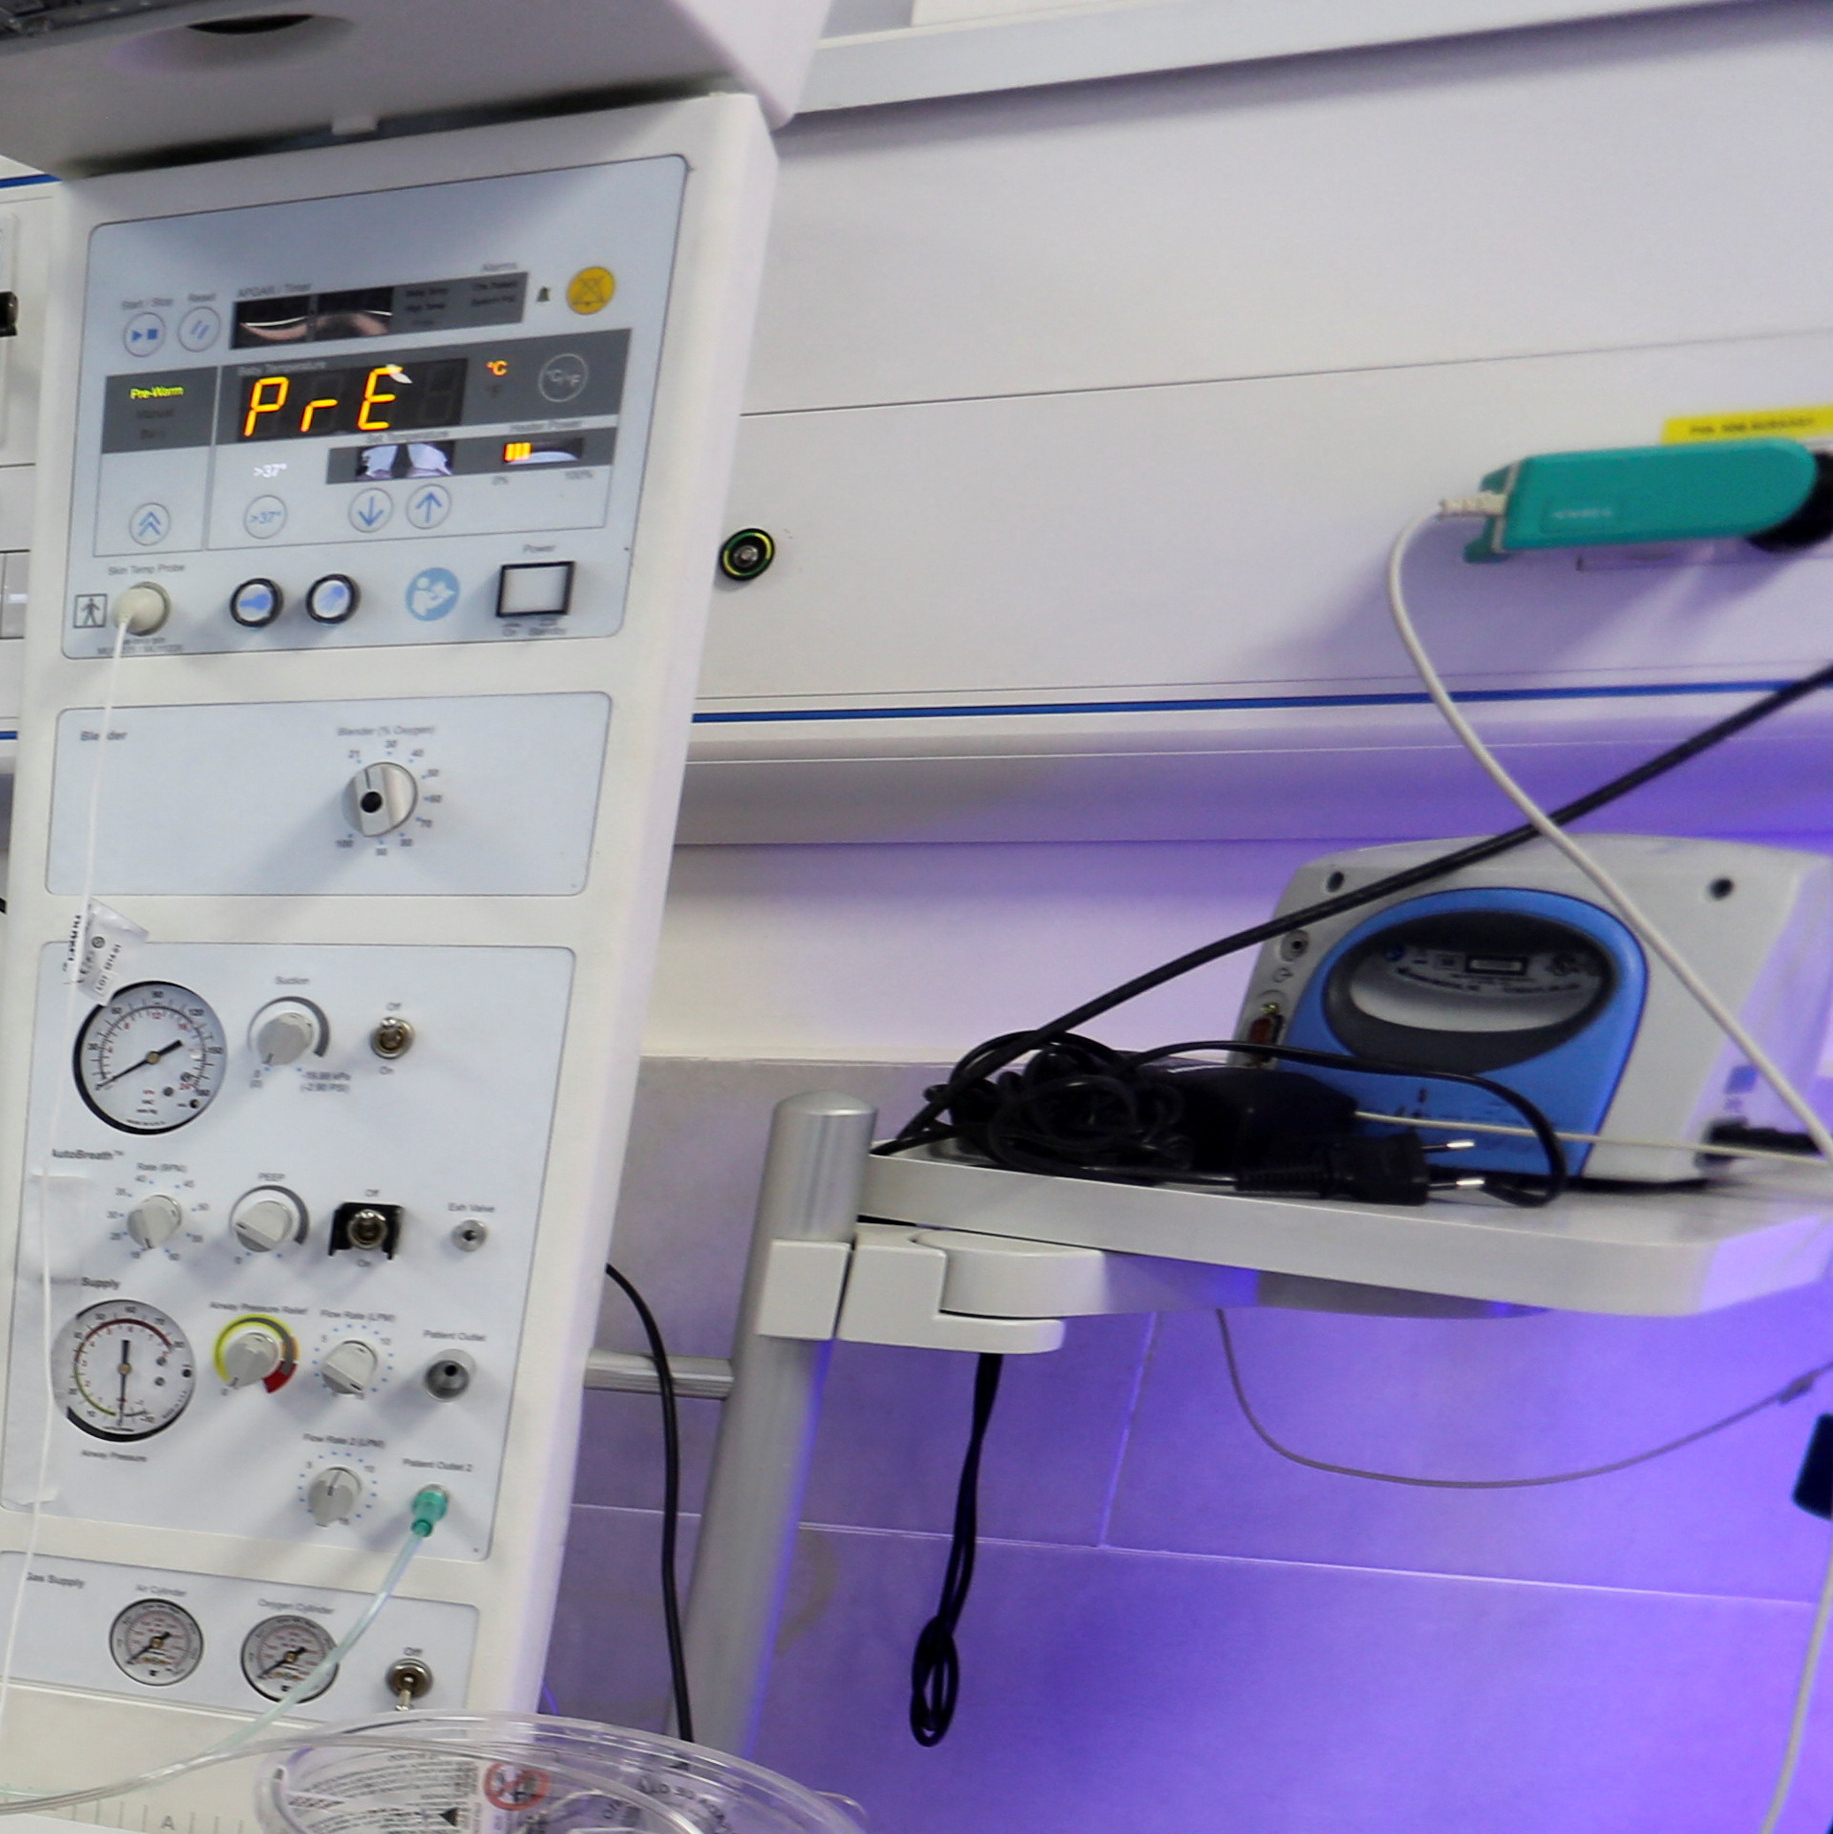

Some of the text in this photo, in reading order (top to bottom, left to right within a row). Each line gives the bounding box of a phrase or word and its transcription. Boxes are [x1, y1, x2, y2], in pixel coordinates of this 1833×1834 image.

[244, 366, 404, 437] PrE
[80, 730, 128, 741] Bleder
[160, 1815, 175, 1831] A
